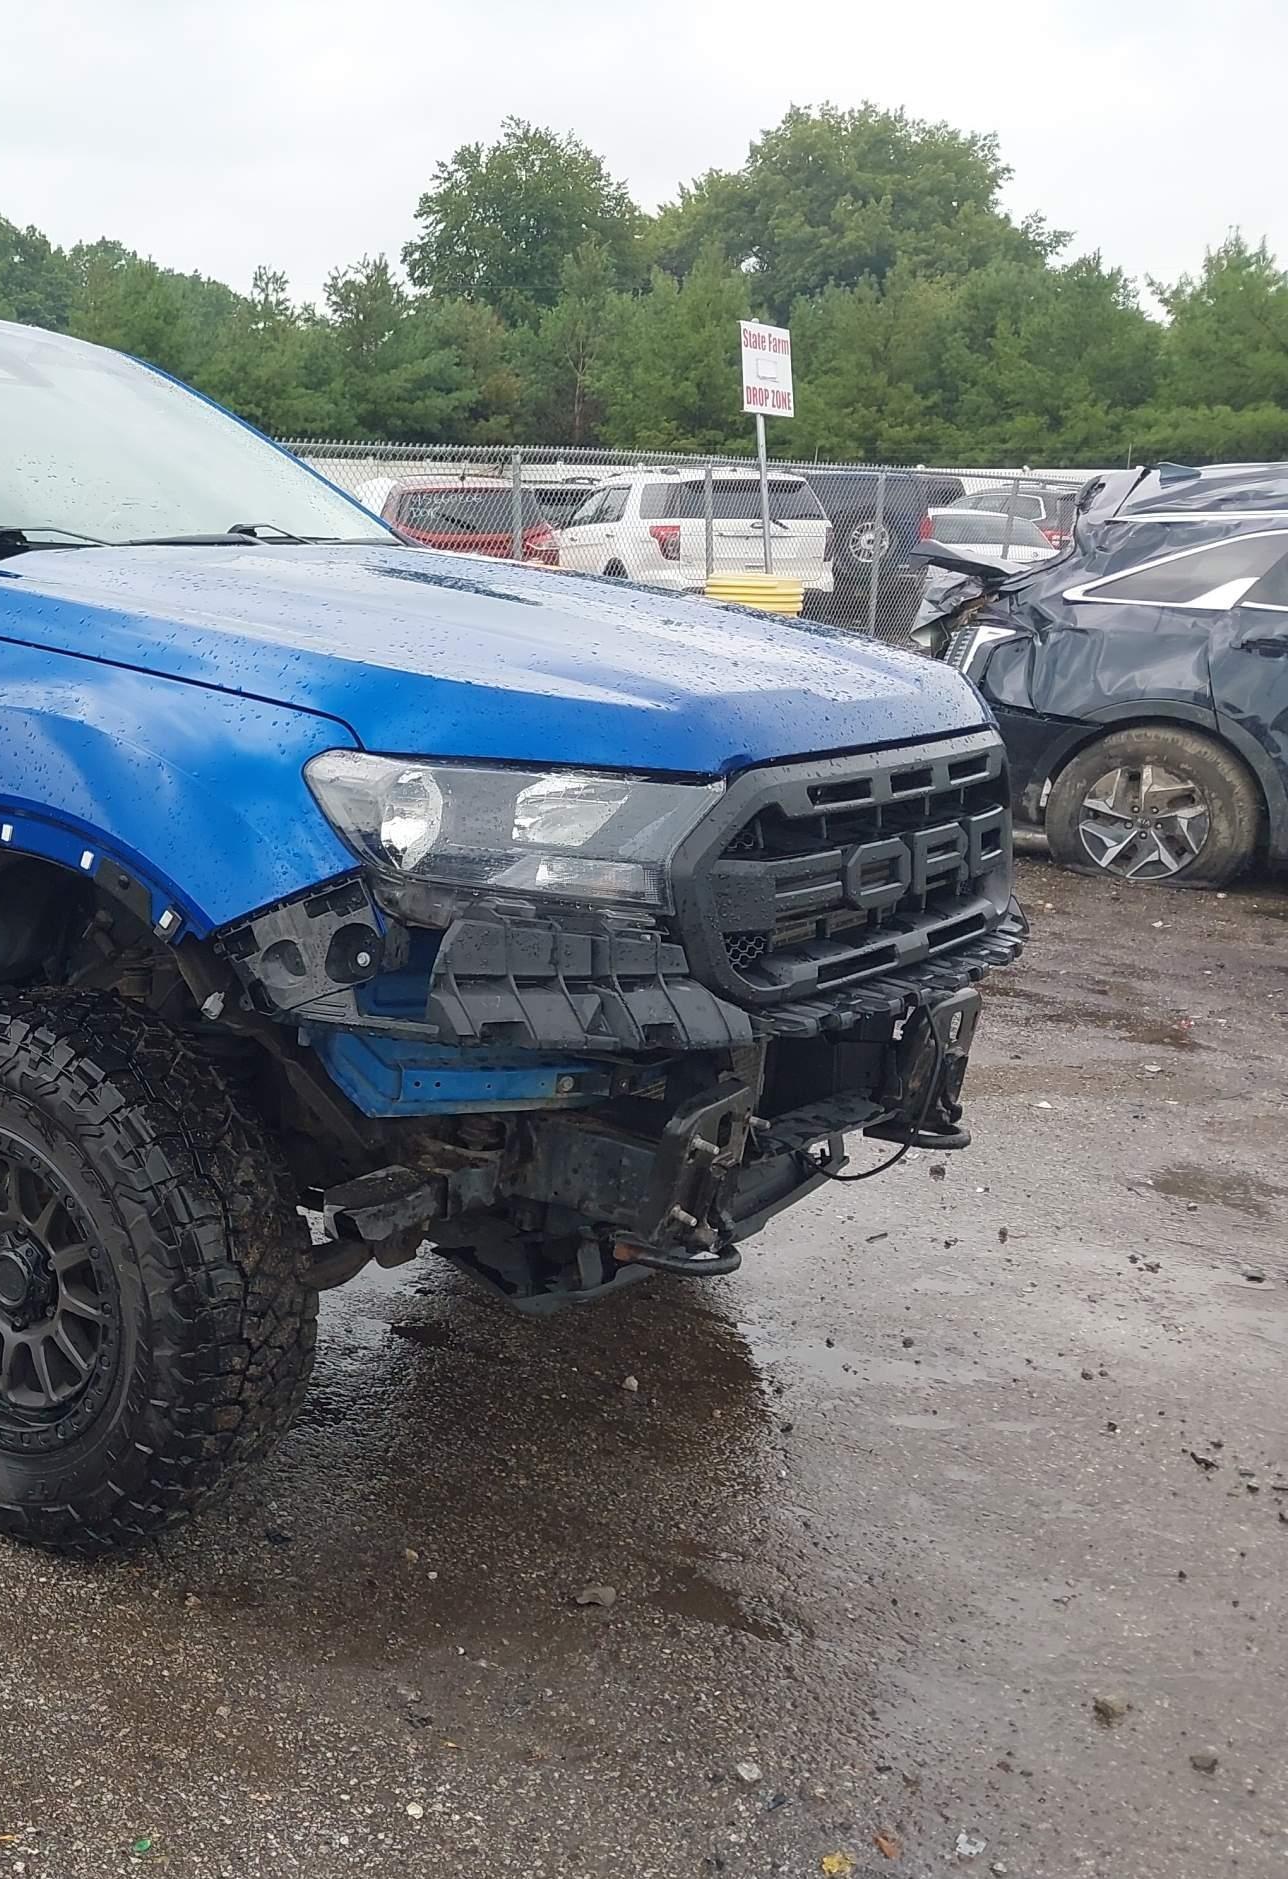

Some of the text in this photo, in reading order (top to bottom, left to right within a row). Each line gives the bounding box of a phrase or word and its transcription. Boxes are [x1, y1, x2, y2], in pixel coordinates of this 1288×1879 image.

[743, 328, 790, 355] State Farm
[746, 386, 792, 410] DROP ZONE
